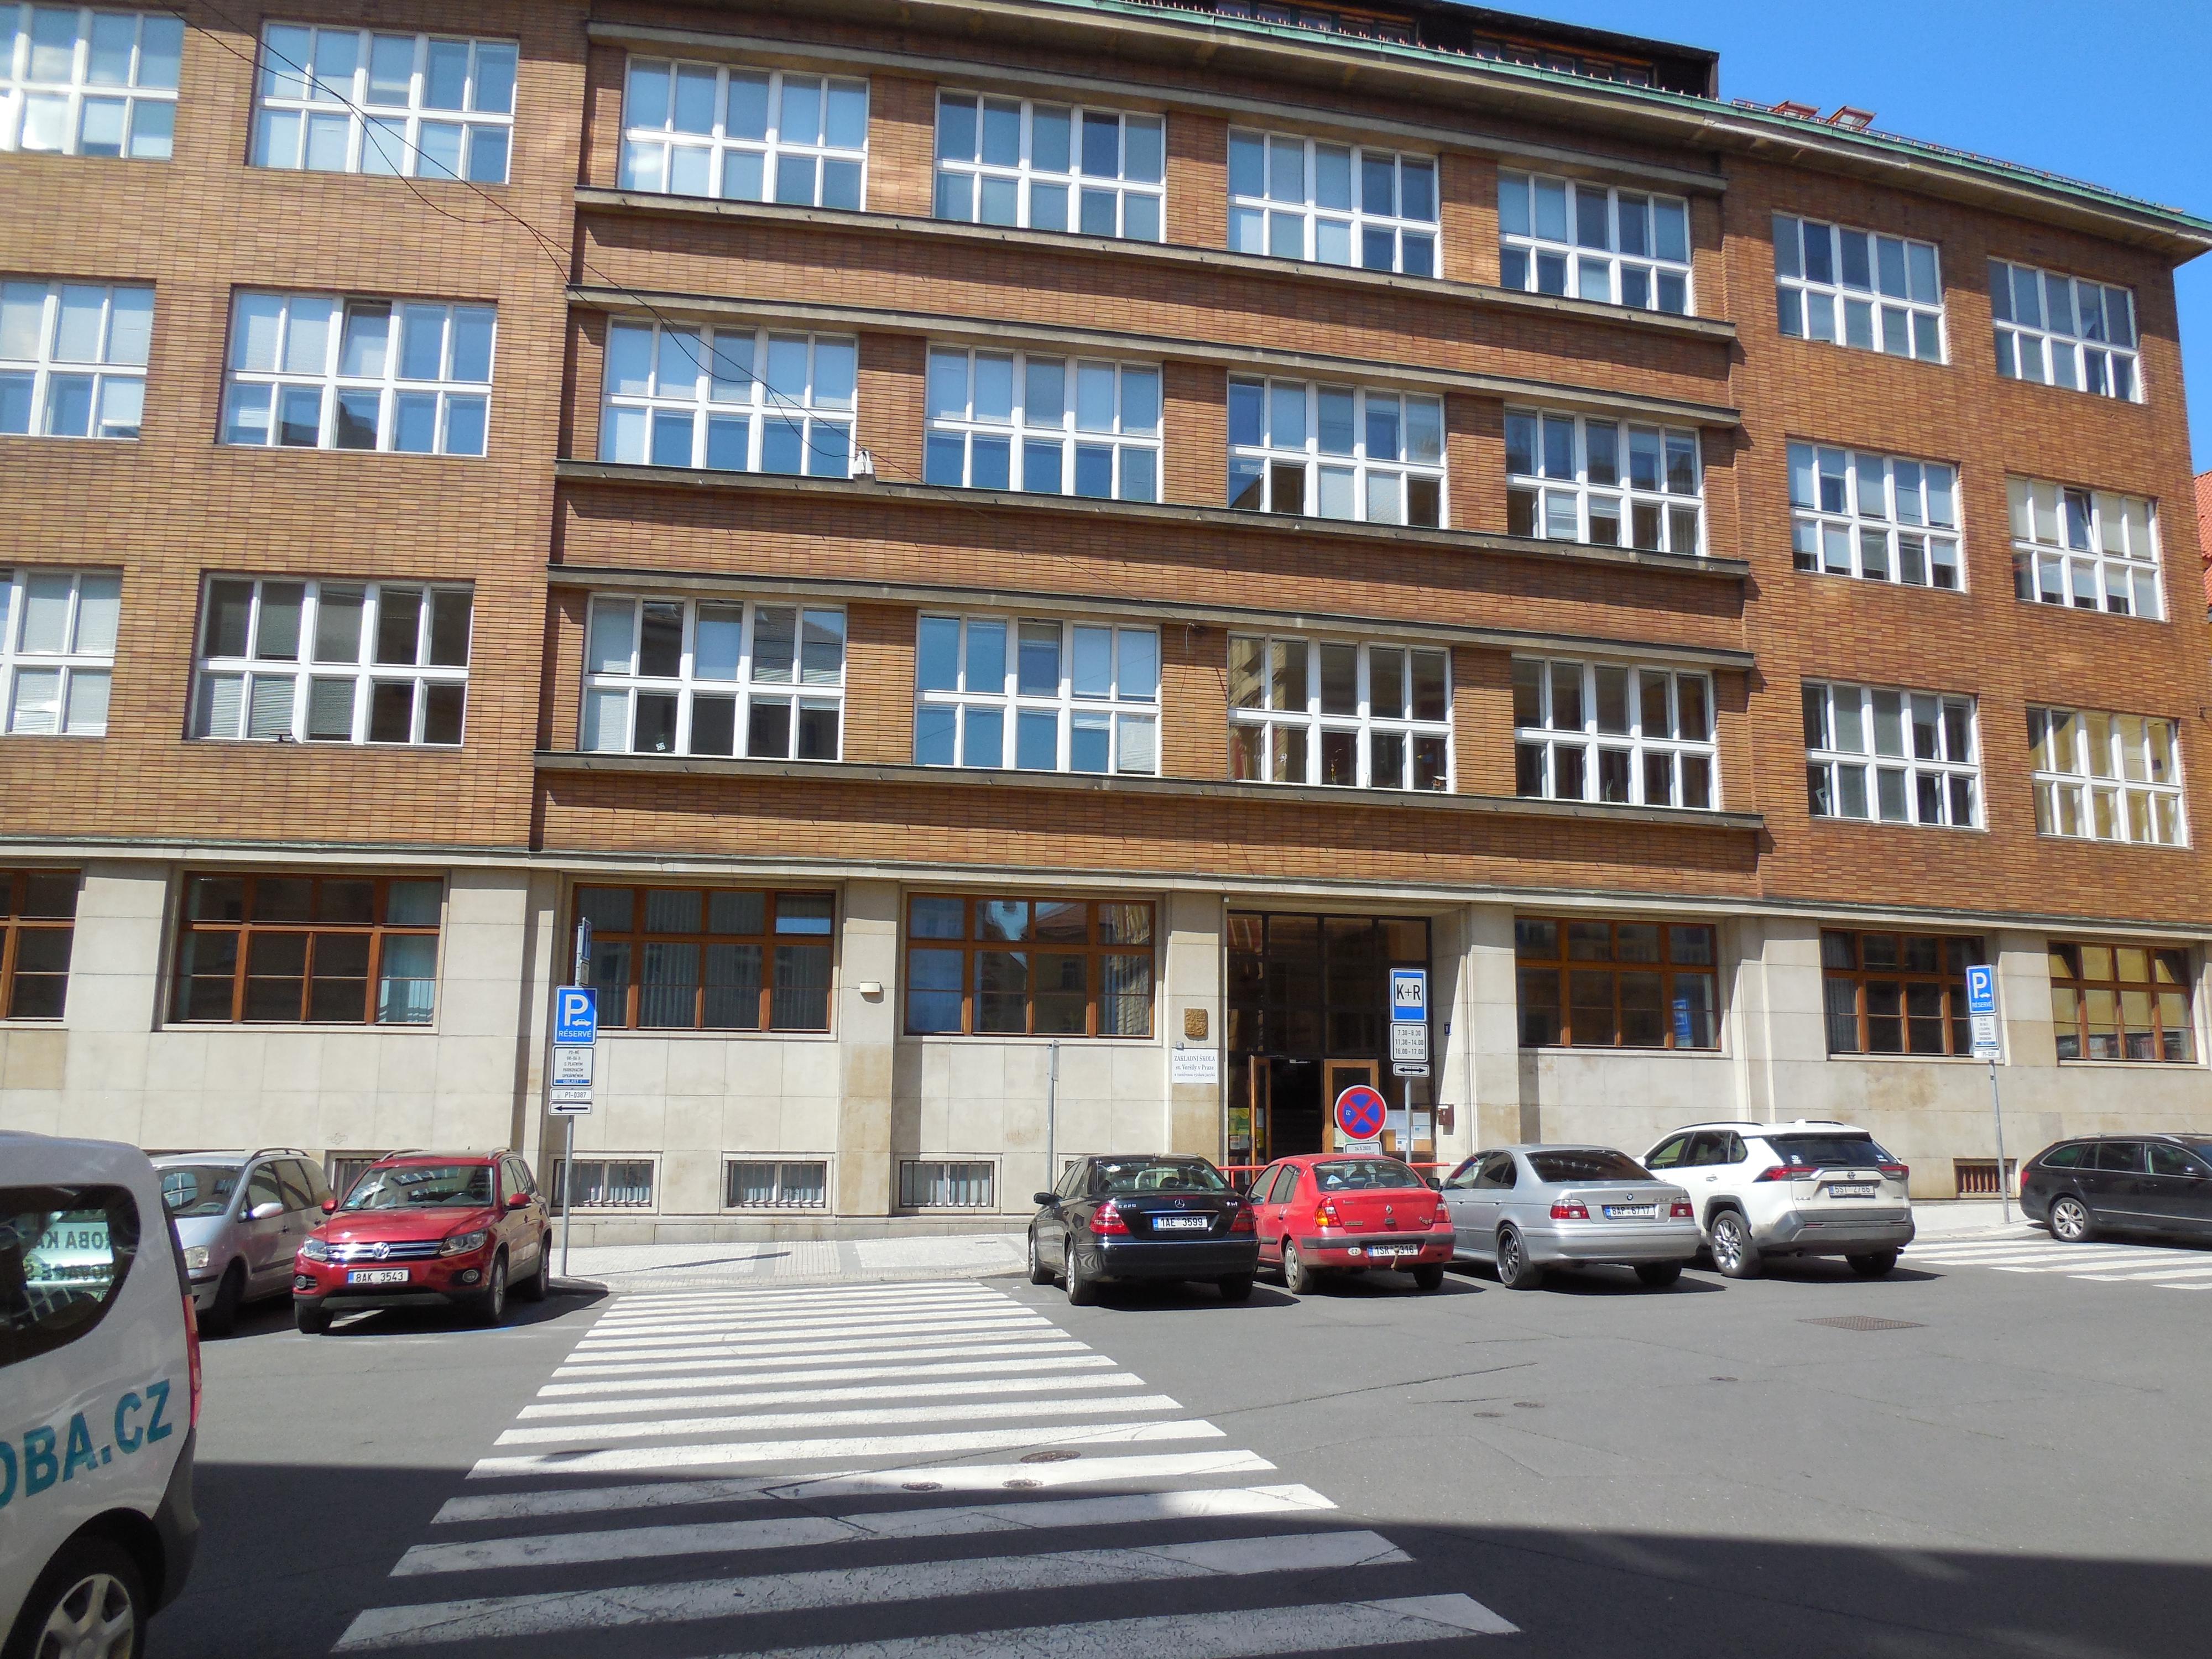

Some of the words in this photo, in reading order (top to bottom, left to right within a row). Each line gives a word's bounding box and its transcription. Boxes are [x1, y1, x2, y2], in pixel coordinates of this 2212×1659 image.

[1972, 972, 1987, 999] P
[1396, 984, 1421, 1000] K+R
[564, 994, 588, 1026] P
[559, 1029, 592, 1037] RÉSERVÉ
[1612, 1207, 1626, 1215] 8AP
[1631, 1206, 1650, 1214] 6717
[1161, 1217, 1176, 1227] 1AE
[1182, 1217, 1203, 1226] 3599
[1375, 1245, 1390, 1255] 1SR
[356, 1272, 373, 1282] 8AK
[380, 1272, 403, 1281] 3543
